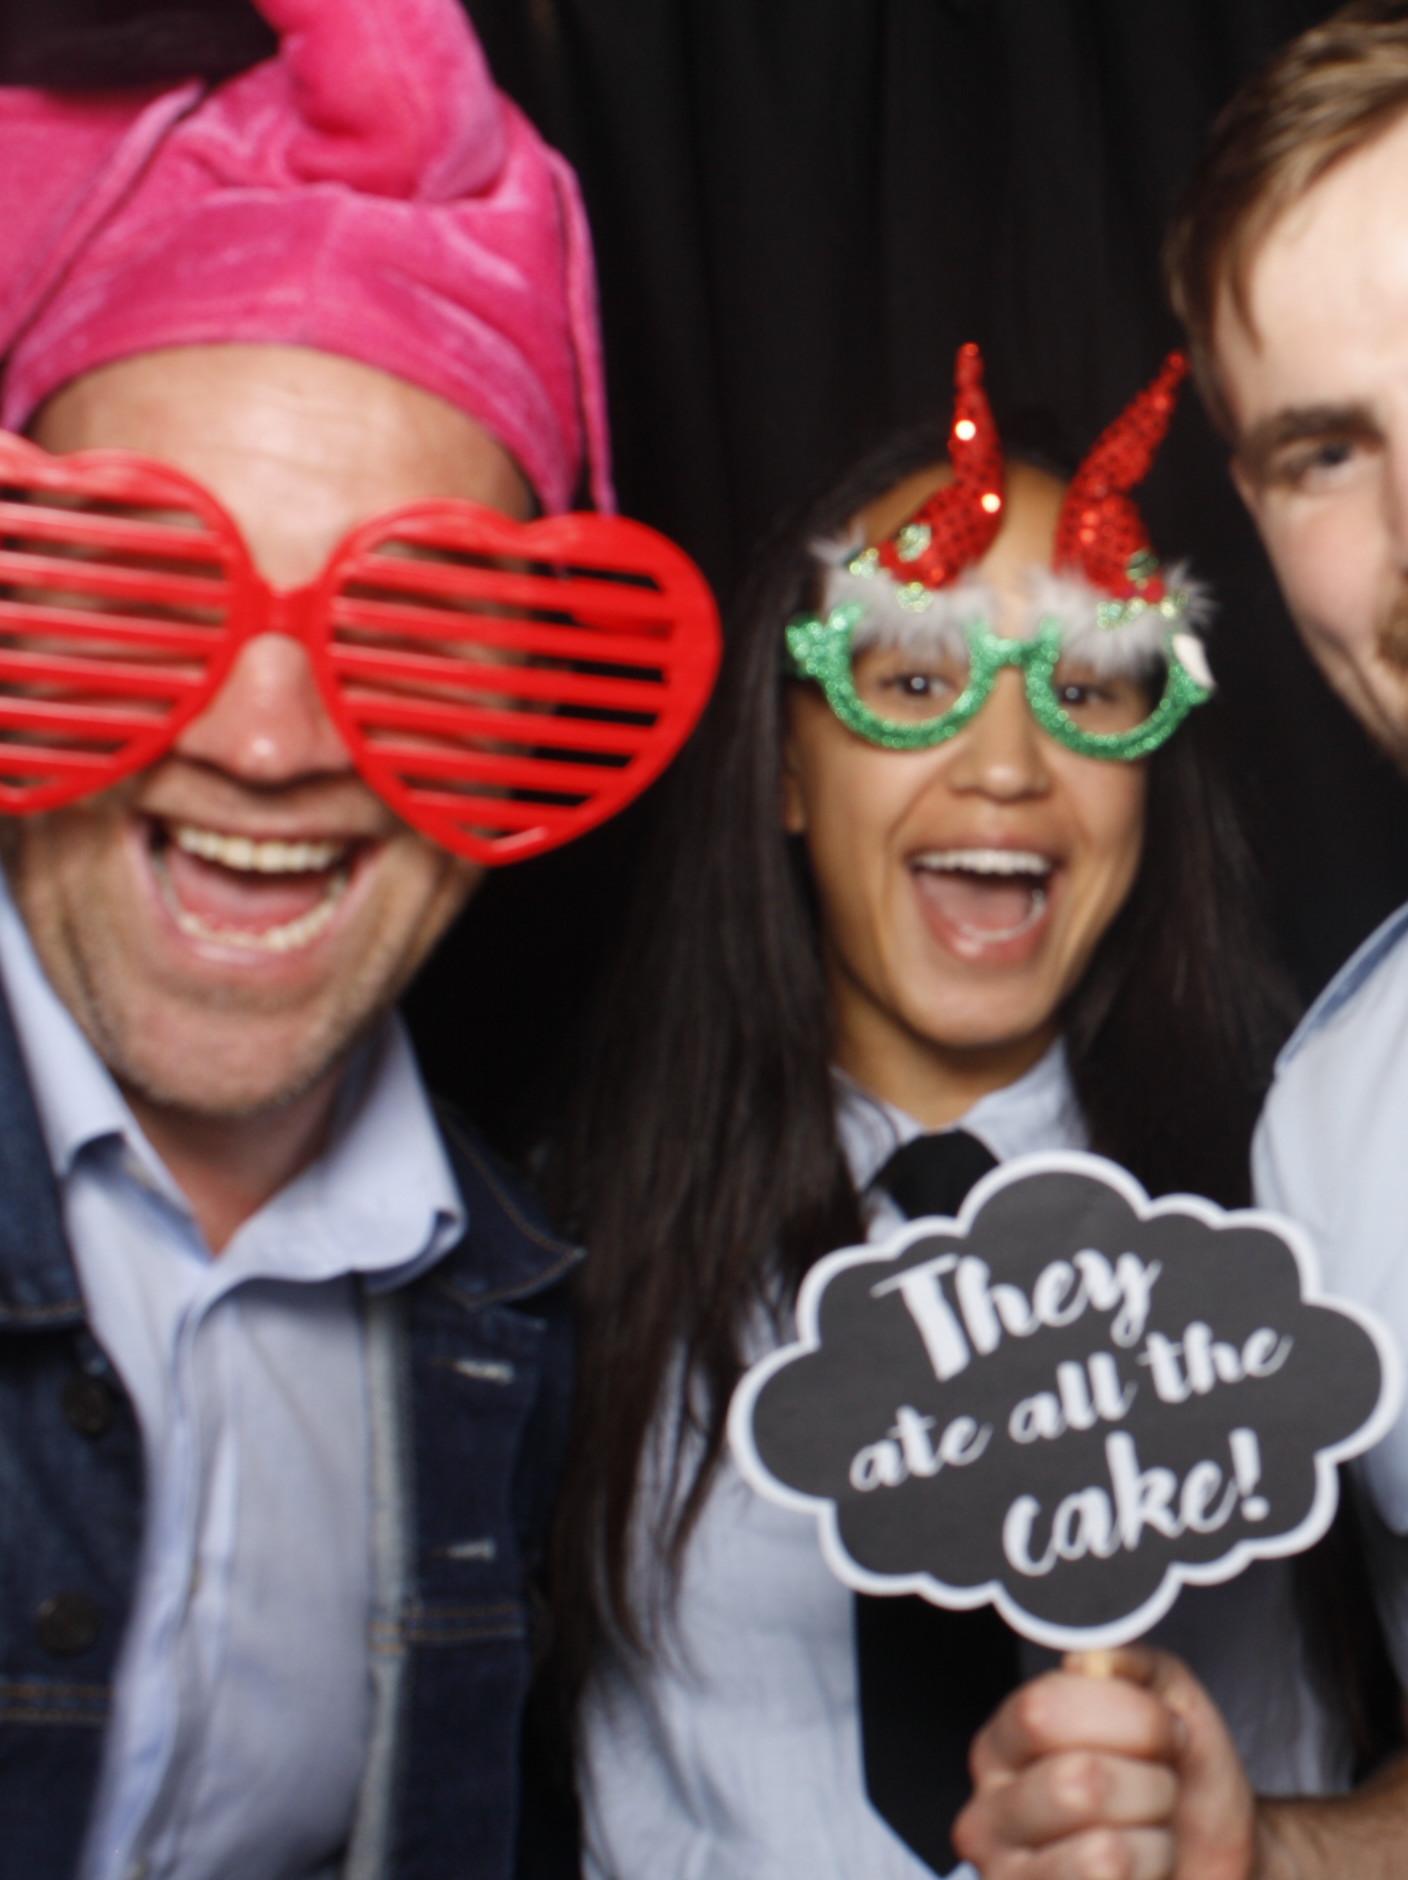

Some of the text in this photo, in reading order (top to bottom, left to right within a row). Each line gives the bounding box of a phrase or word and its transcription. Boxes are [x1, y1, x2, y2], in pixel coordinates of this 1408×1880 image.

[872, 1248, 1161, 1382] They
[849, 1321, 1293, 1491] ate all the
[1002, 1428, 1270, 1577] cake!
